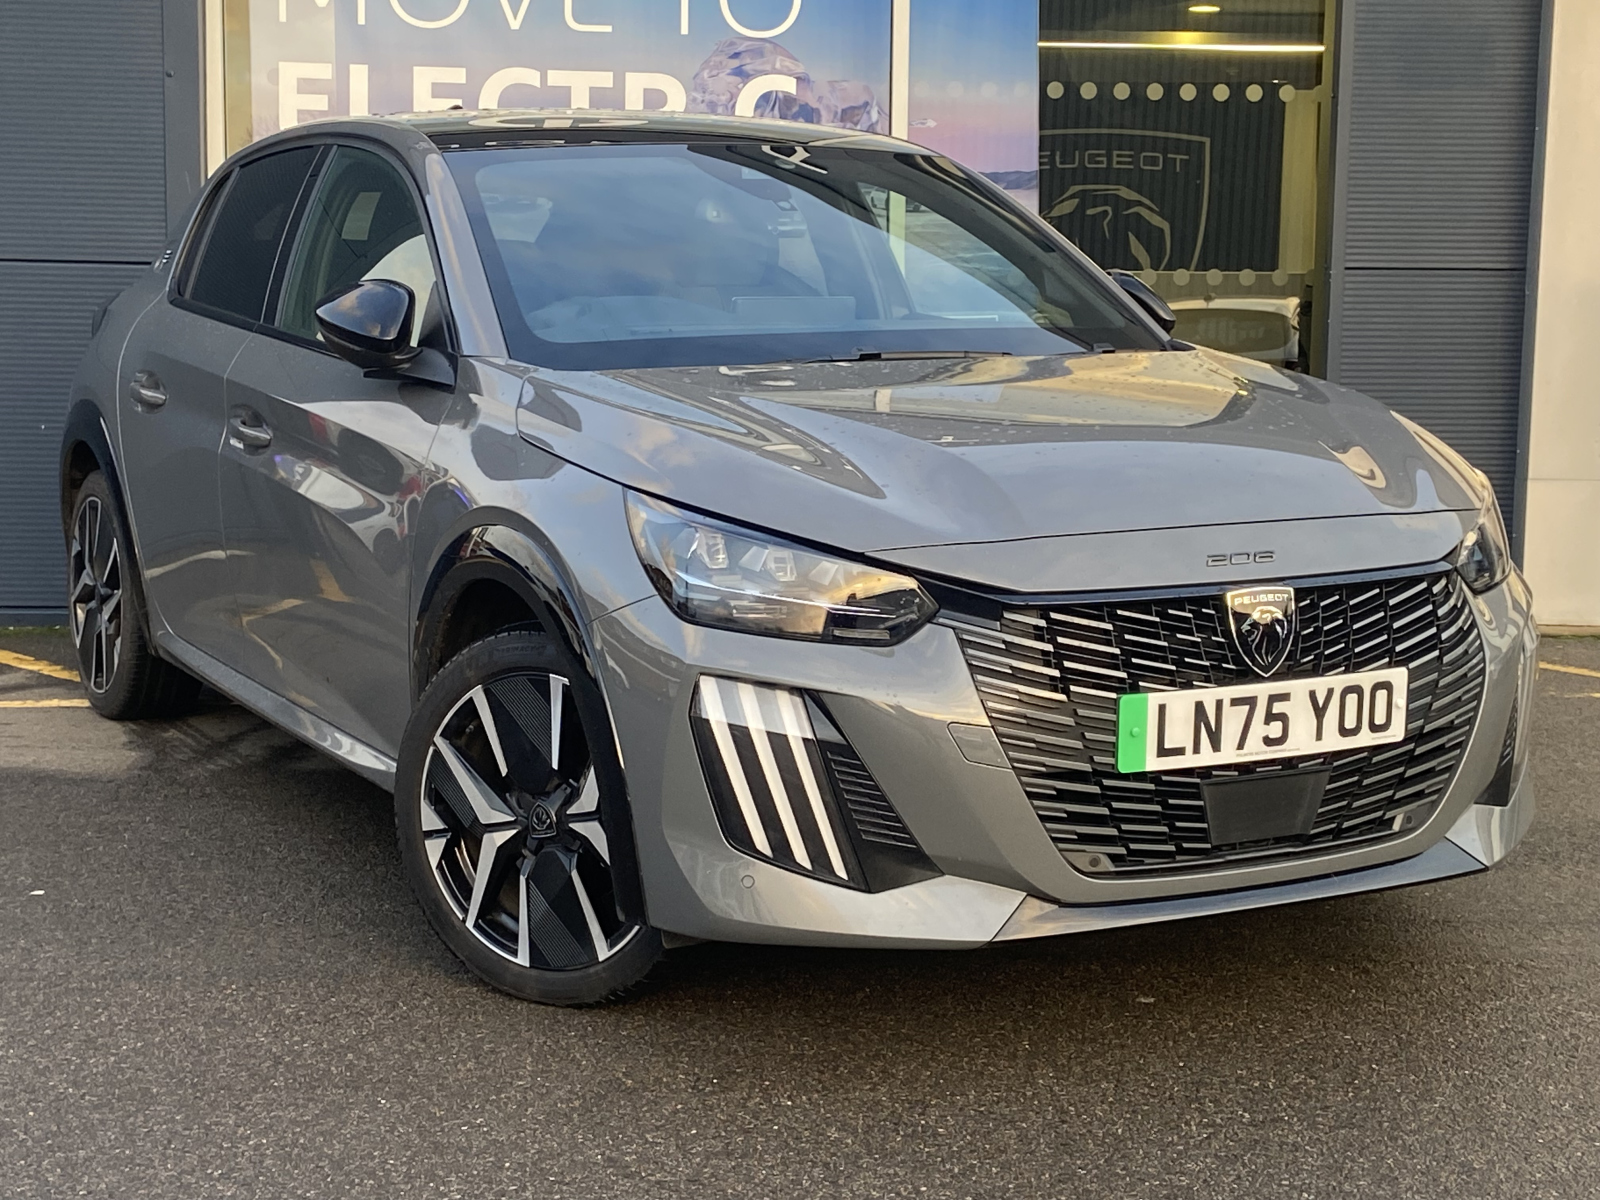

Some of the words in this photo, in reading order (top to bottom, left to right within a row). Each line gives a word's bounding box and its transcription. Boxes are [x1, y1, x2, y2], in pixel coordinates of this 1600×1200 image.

[1040, 151, 1189, 172] EUGEOT
[1234, 593, 1288, 605] PEUGEOT
[1156, 692, 1291, 758] LN75
